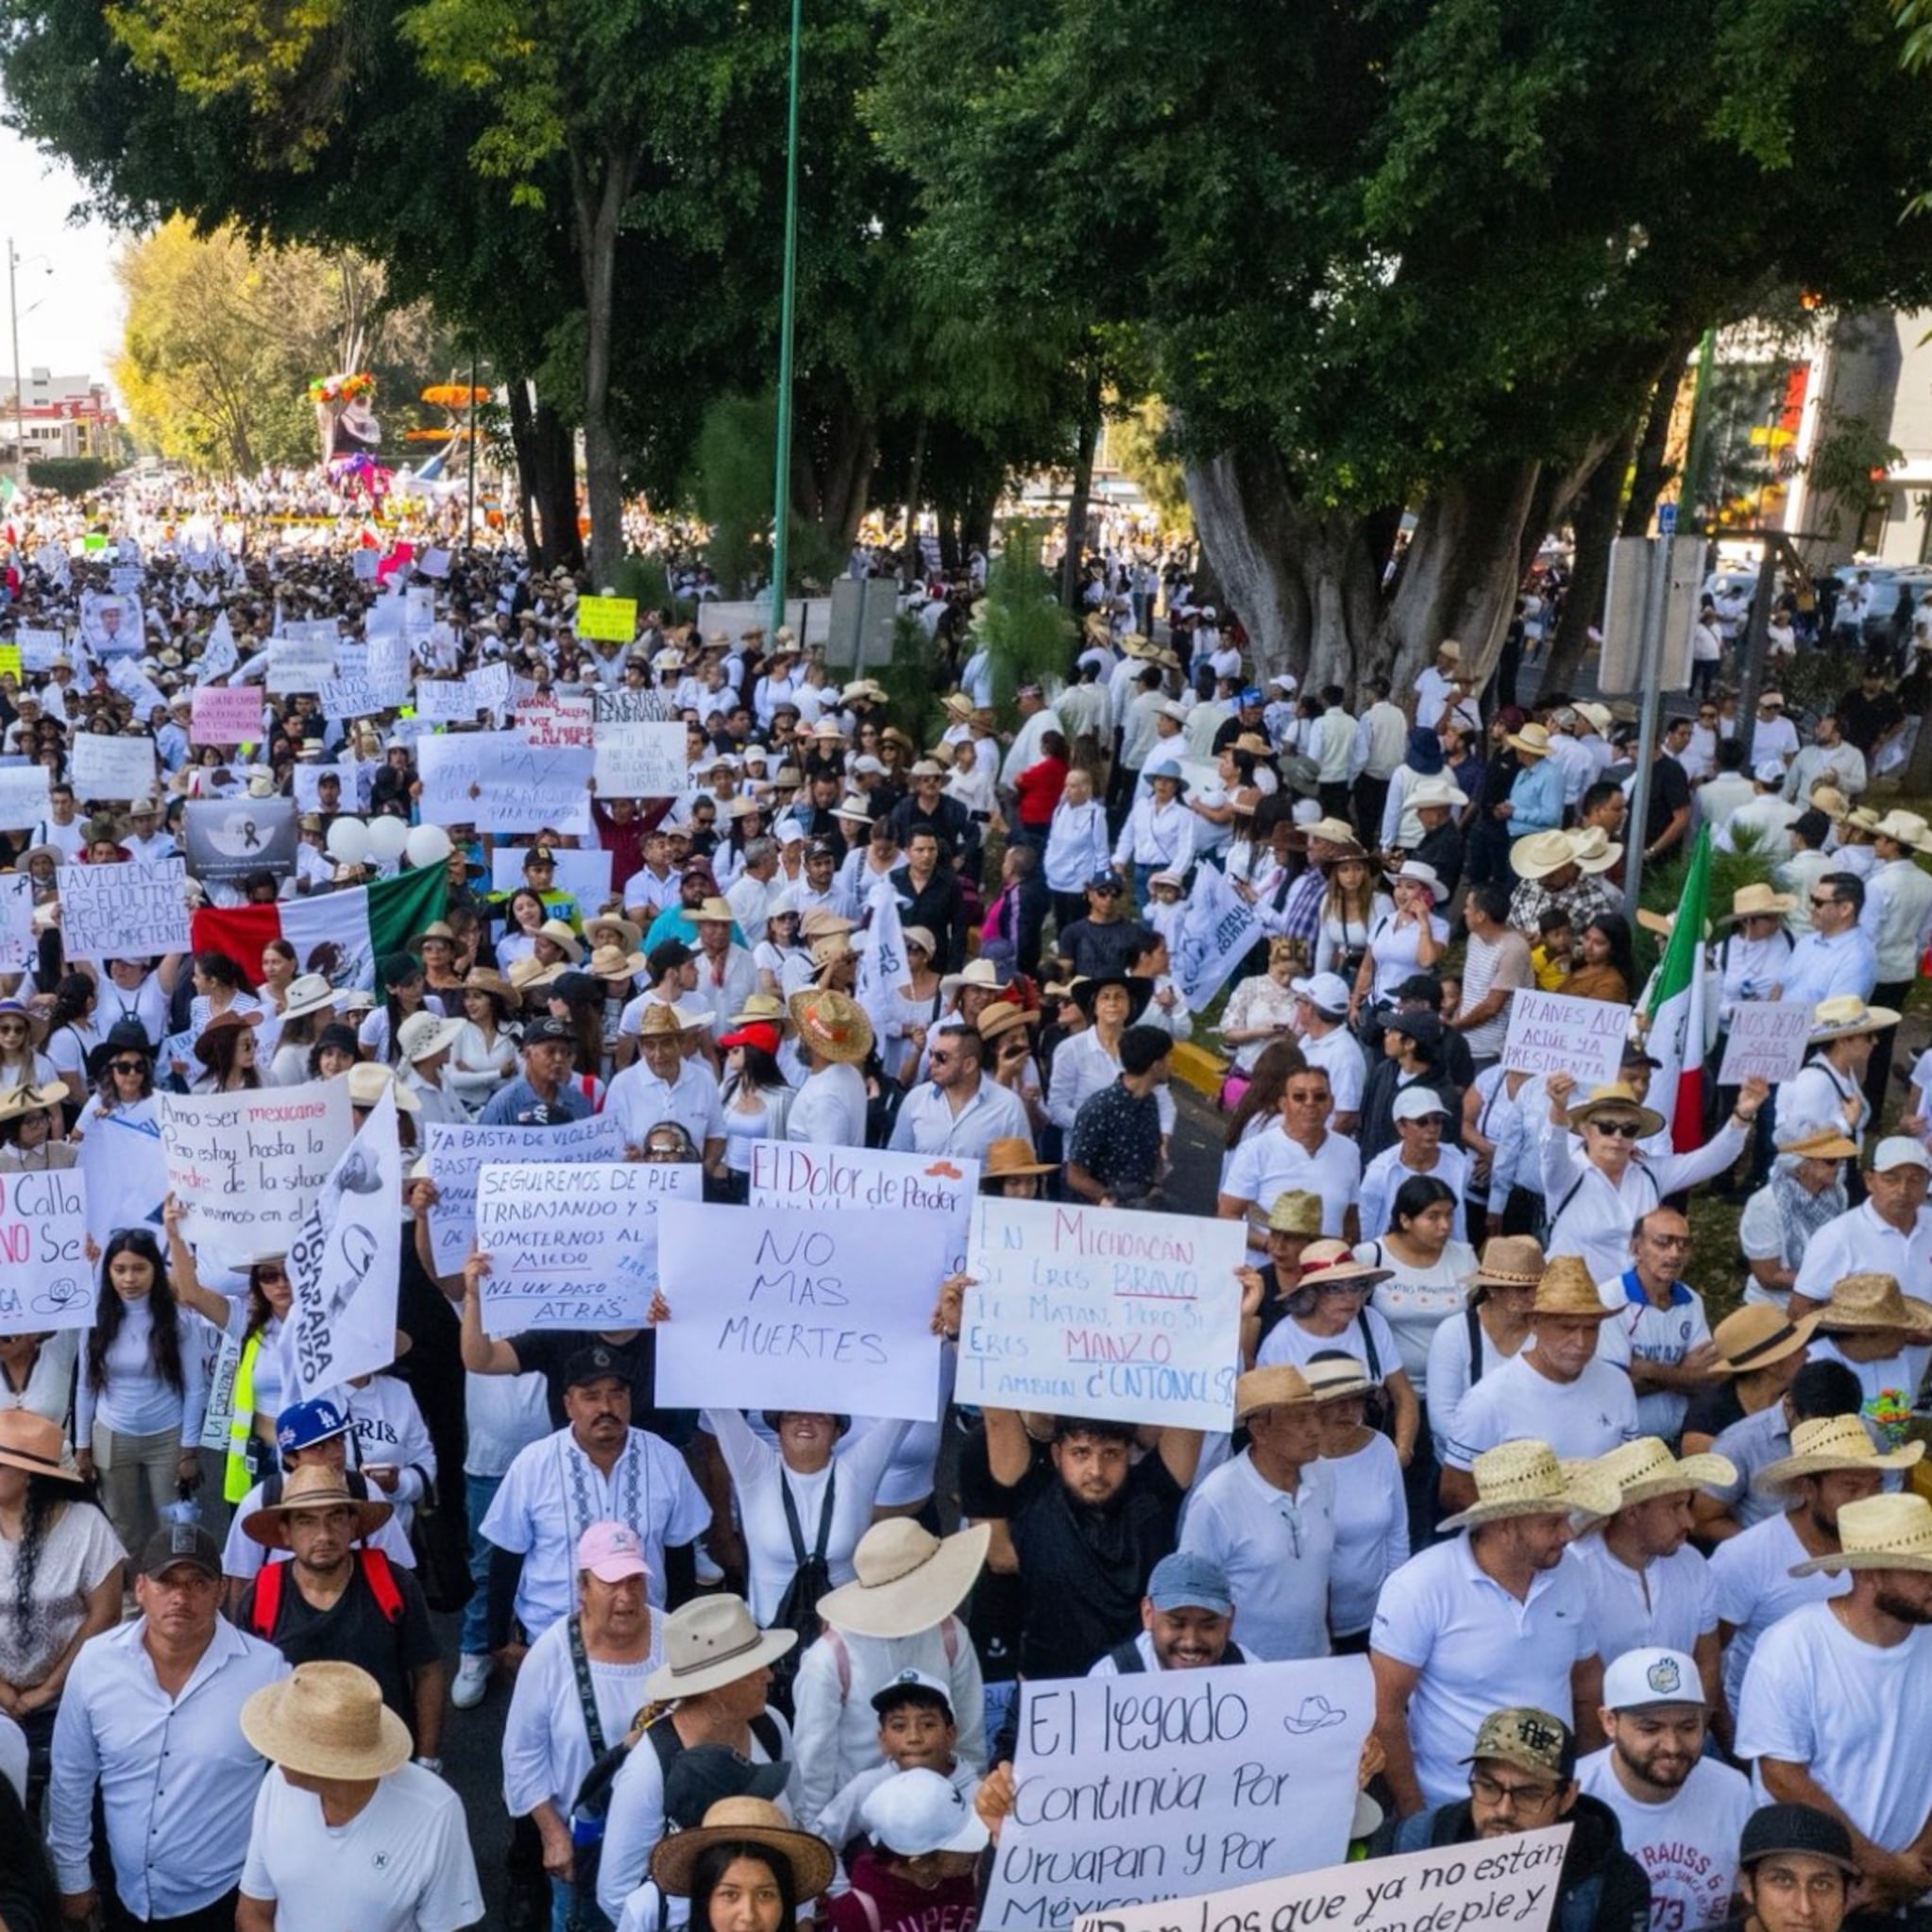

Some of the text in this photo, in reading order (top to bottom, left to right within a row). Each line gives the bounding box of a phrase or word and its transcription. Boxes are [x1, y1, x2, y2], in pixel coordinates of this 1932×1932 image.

[80, 860, 183, 888] VIOLENCIA
[64, 902, 187, 931] RECURSO DEL
[67, 890, 93, 910] ES
[68, 923, 188, 952] INCOMPETENTE
[1518, 996, 1626, 1032] PLANES NO
[1505, 1045, 1605, 1078] PRESIDENTA
[1578, 1038, 1601, 1051] YA
[161, 1095, 200, 1127] Amo
[205, 1109, 240, 1127] ser
[161, 1124, 324, 1169] Pero estoy hasta la
[431, 1120, 619, 1151] YA BASTA DE VIOLENCIA
[14, 1174, 82, 1216] Calla
[223, 1166, 246, 1194] de
[260, 1161, 277, 1190] la
[484, 1169, 681, 1195] SEGUIREMOS DE PIE
[754, 1144, 963, 1212] El Dolor de Perder
[260, 1209, 281, 1222] en
[483, 1200, 618, 1224] TRABAJANDO
[980, 1199, 1024, 1250] EN
[41, 1223, 80, 1263] Se
[482, 1229, 644, 1250] SOMETERNOS AL
[755, 1229, 836, 1266] NO
[513, 1251, 588, 1269] MIEDO
[522, 1282, 552, 1296] UN
[559, 1282, 607, 1296] PASO
[749, 1270, 851, 1306] MAS
[1113, 1262, 1198, 1296] BRAVO
[297, 1281, 316, 1384] MNZO
[718, 1316, 889, 1364] MUERTES
[971, 1325, 1172, 1364] ERES MANZO
[979, 1358, 1076, 1397] TAMBIEN
[1029, 1682, 1248, 1756] El legado
[1012, 1761, 1291, 1827] Continúa Por
[1002, 1843, 1166, 1885] Uruapan
[1221, 1831, 1278, 1874] Por
[1272, 1894, 1347, 1931] que
[1354, 1875, 1407, 1927] ya
[1419, 1861, 1466, 1890] no
[1416, 1902, 1457, 1932] de
[1455, 1890, 1516, 1932] pie
